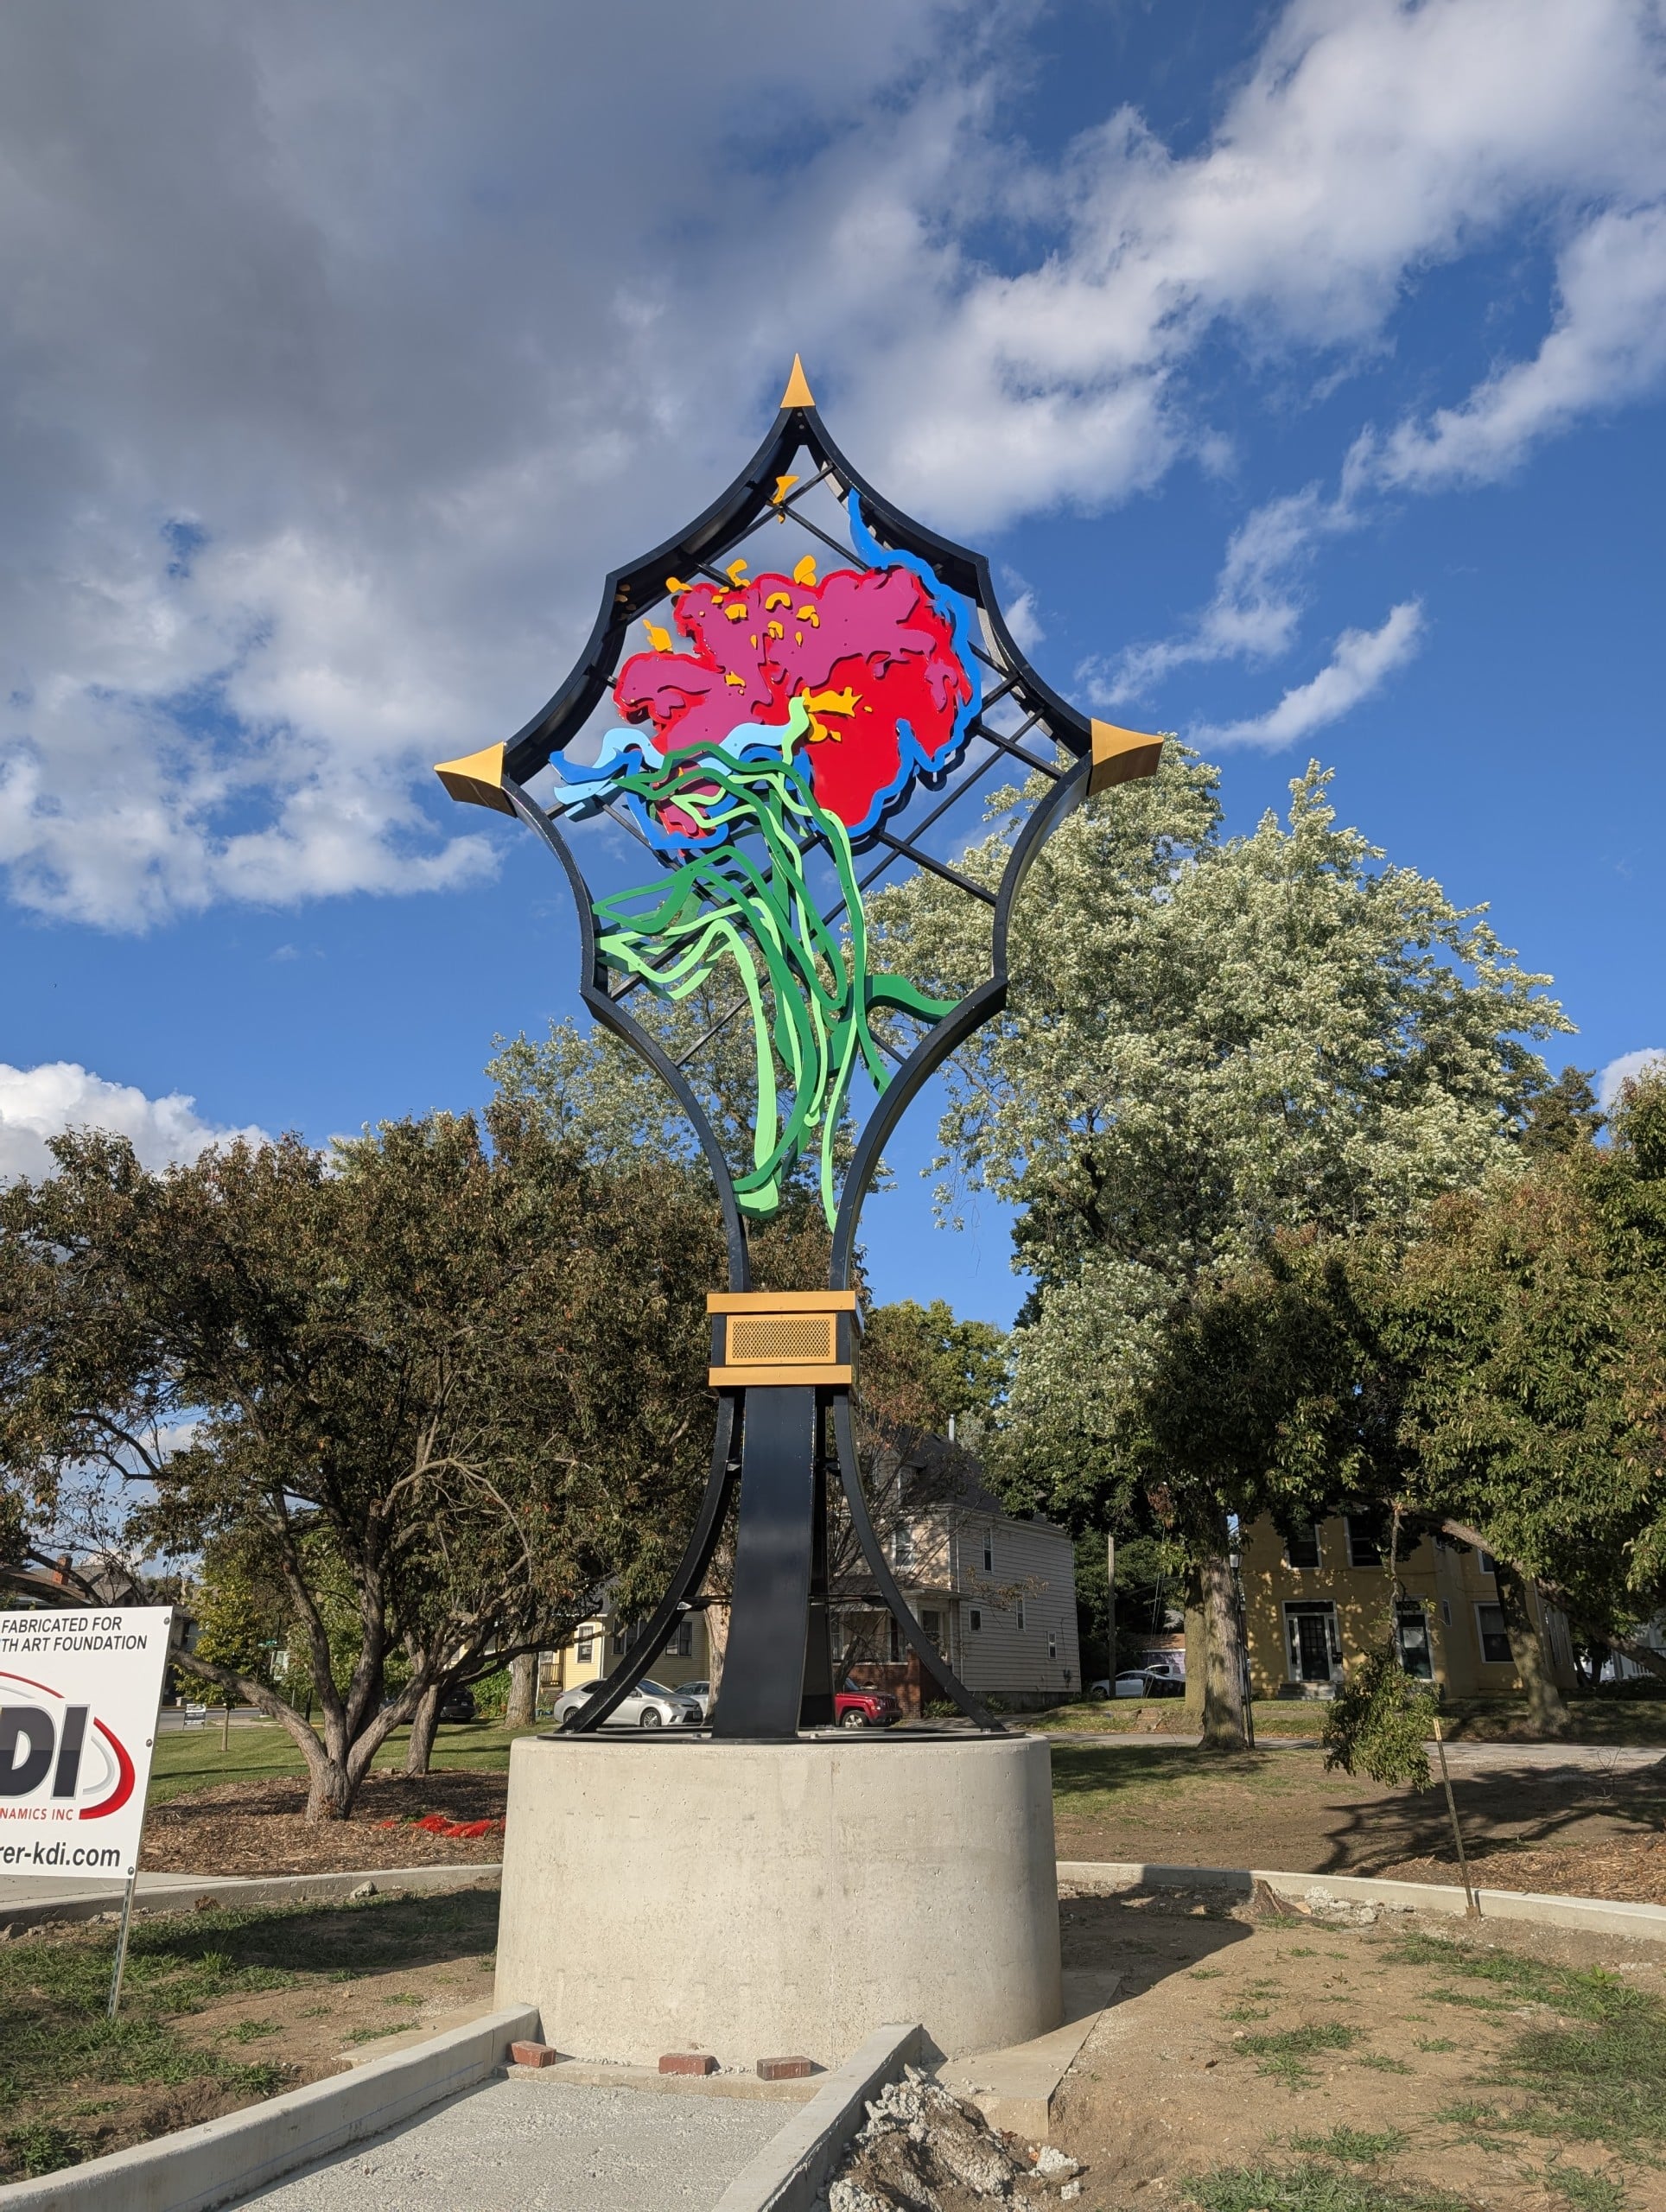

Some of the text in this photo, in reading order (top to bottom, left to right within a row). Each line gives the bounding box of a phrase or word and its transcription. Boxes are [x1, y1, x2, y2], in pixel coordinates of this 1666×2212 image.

[1, 1616, 123, 1634] FABRICATED FOR
[2, 1635, 148, 1652] TH ART FOUNDATION
[0, 1808, 73, 1821] NAMICS INC
